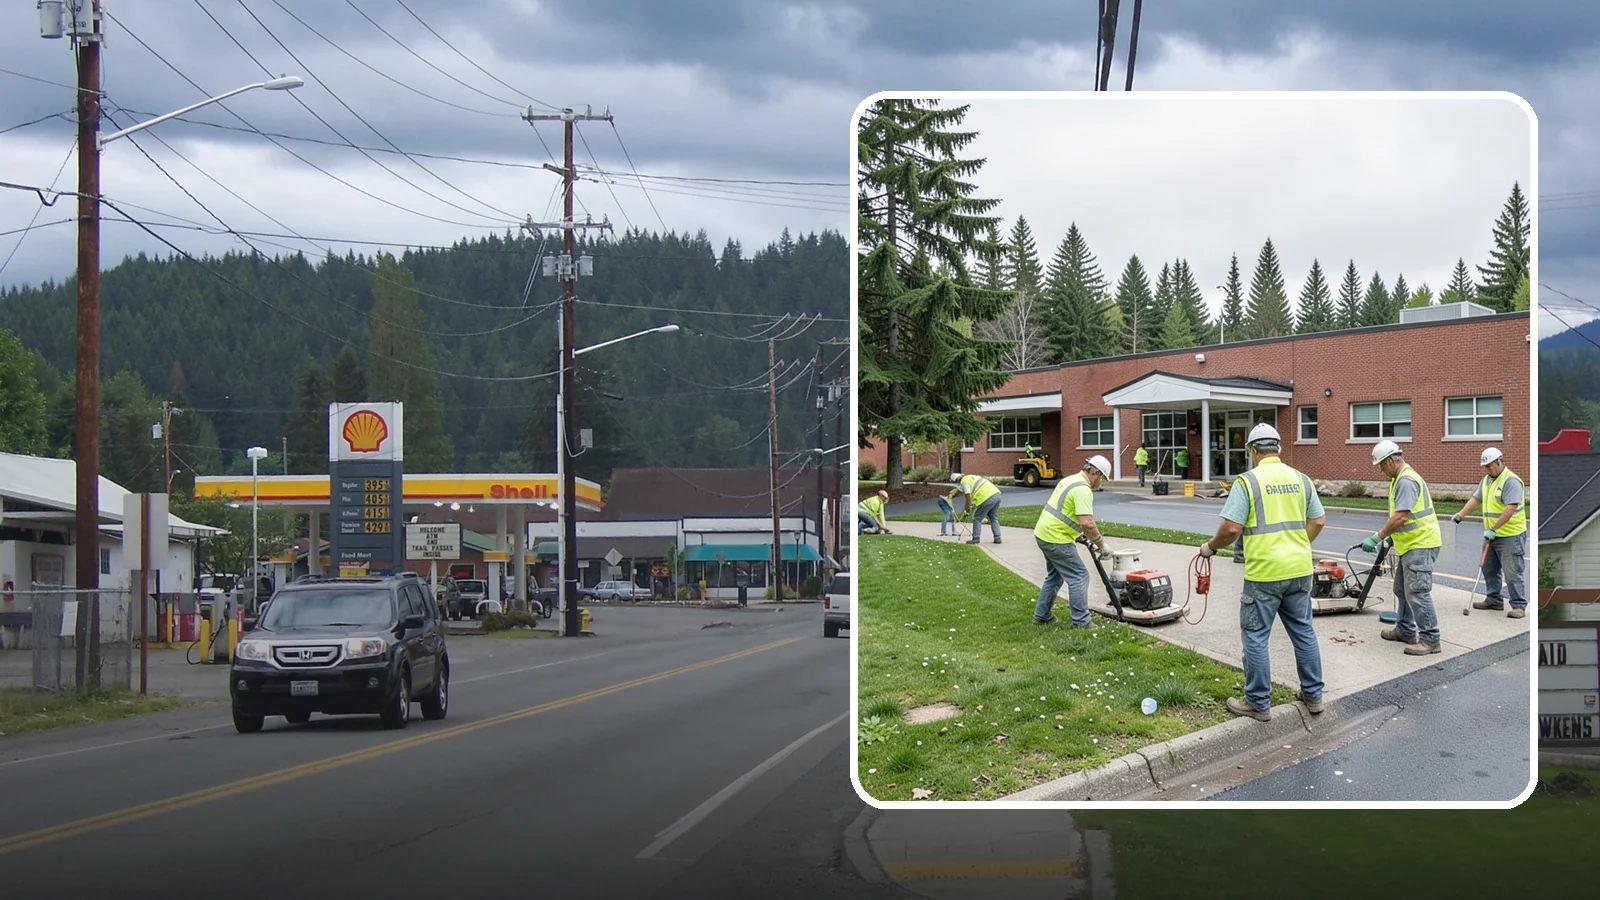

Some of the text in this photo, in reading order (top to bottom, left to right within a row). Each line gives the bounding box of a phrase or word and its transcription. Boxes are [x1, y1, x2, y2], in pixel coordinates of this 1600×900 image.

[366, 480, 383, 490] 395
[489, 484, 547, 499] Shell
[366, 494, 383, 504] 405
[366, 508, 383, 518] 415
[366, 522, 383, 533] 429
[1538, 642, 1567, 665] AID
